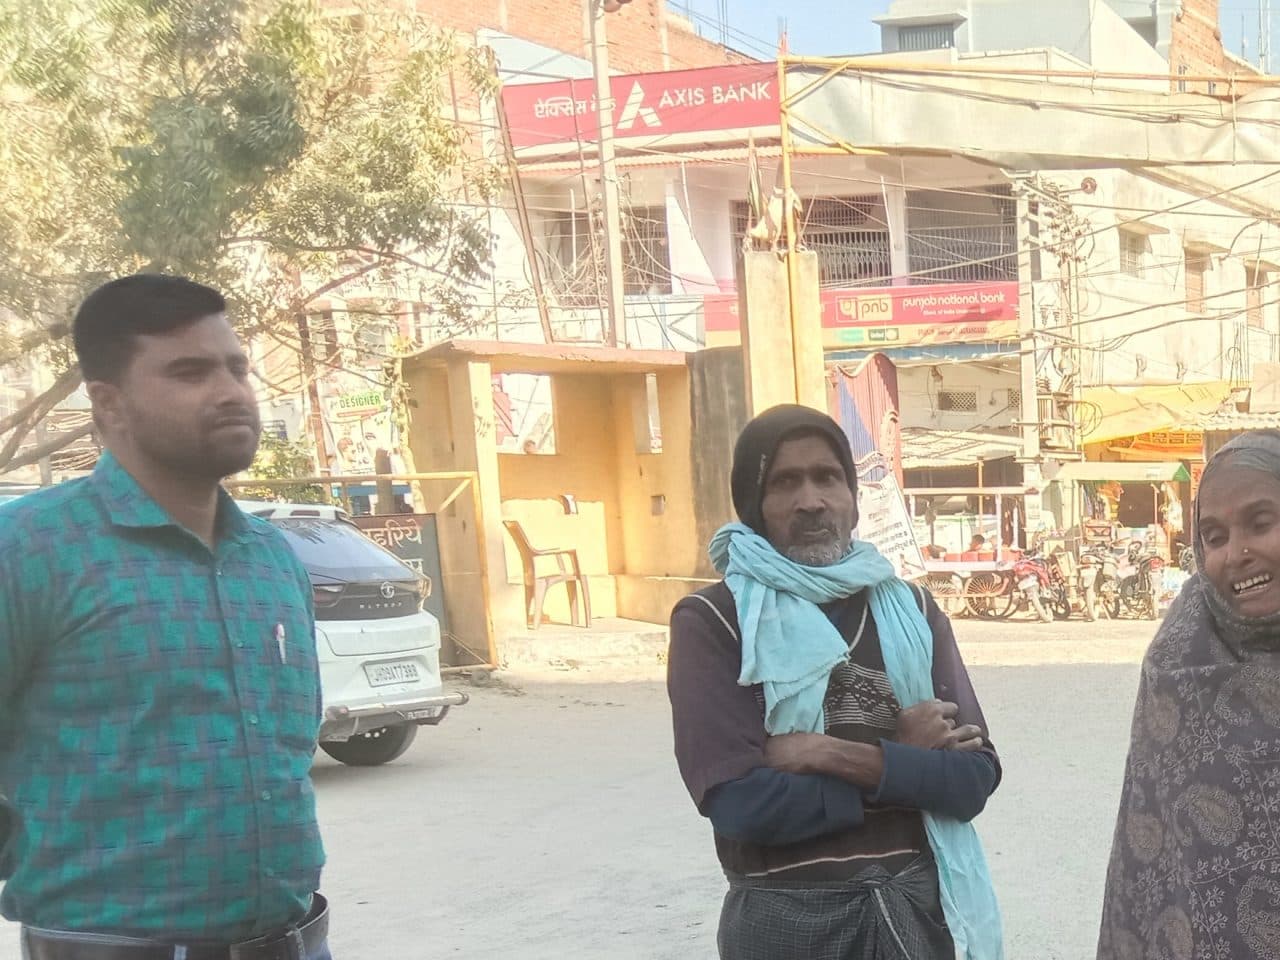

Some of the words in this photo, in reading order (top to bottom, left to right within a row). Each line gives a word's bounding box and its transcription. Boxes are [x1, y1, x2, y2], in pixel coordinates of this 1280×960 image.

[659, 87, 705, 108] AXIS
[712, 81, 772, 105] BANK
[861, 299, 889, 318] pnb
[902, 297, 937, 312] punjab
[938, 293, 978, 306] national
[980, 291, 1006, 305] bank
[340, 394, 380, 409] DESIGNER
